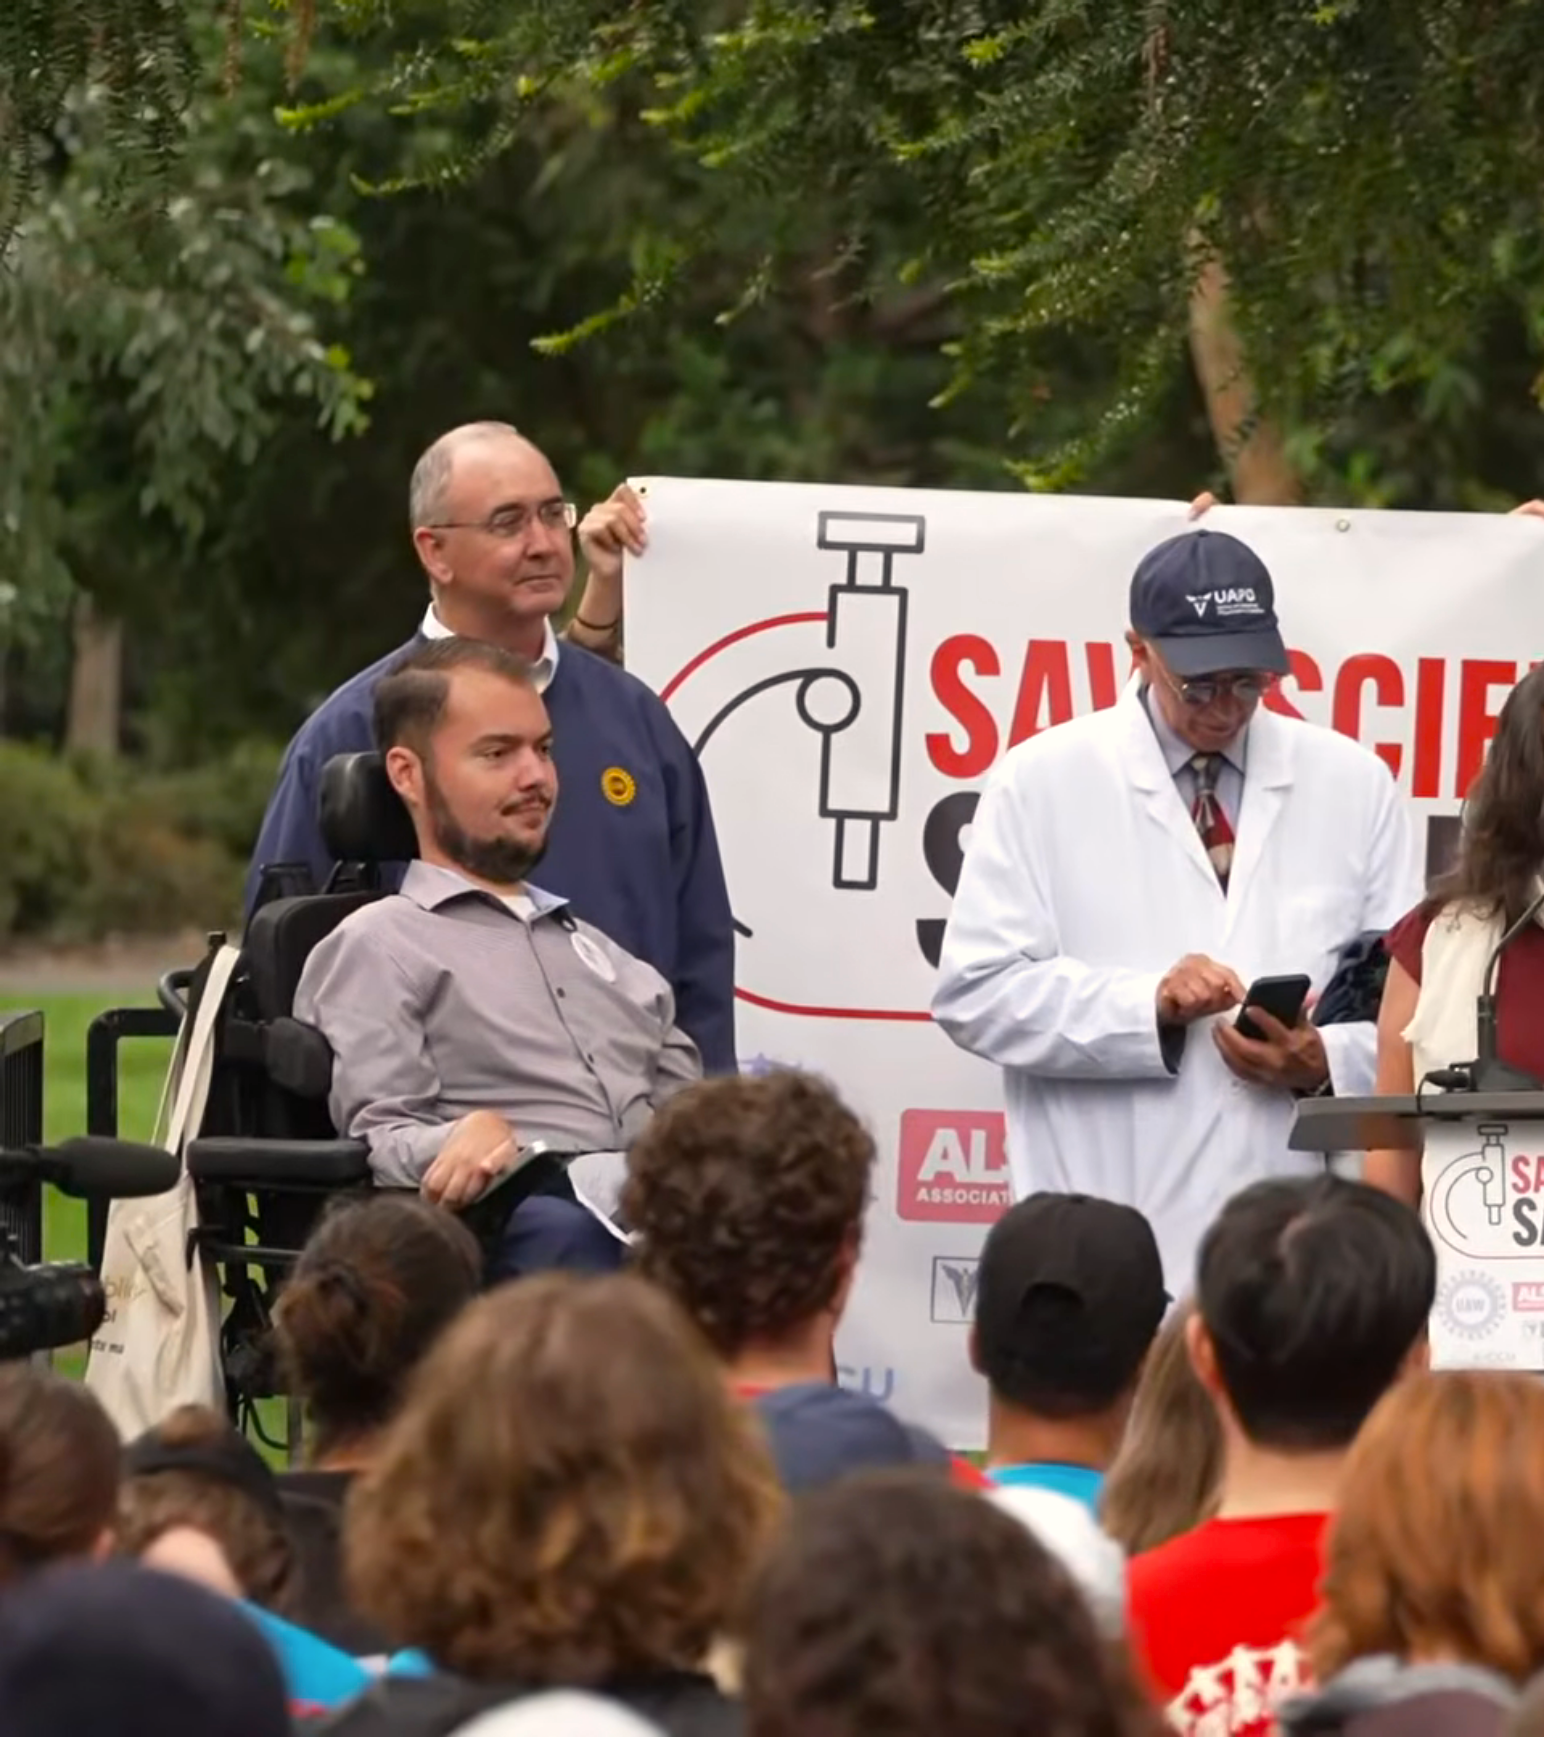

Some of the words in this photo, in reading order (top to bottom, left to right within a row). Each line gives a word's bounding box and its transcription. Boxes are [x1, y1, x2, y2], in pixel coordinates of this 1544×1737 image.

[925, 633, 1140, 779] SA
[917, 1128, 1011, 1184] AL
[916, 1187, 1013, 1206] ASSOCIAT
